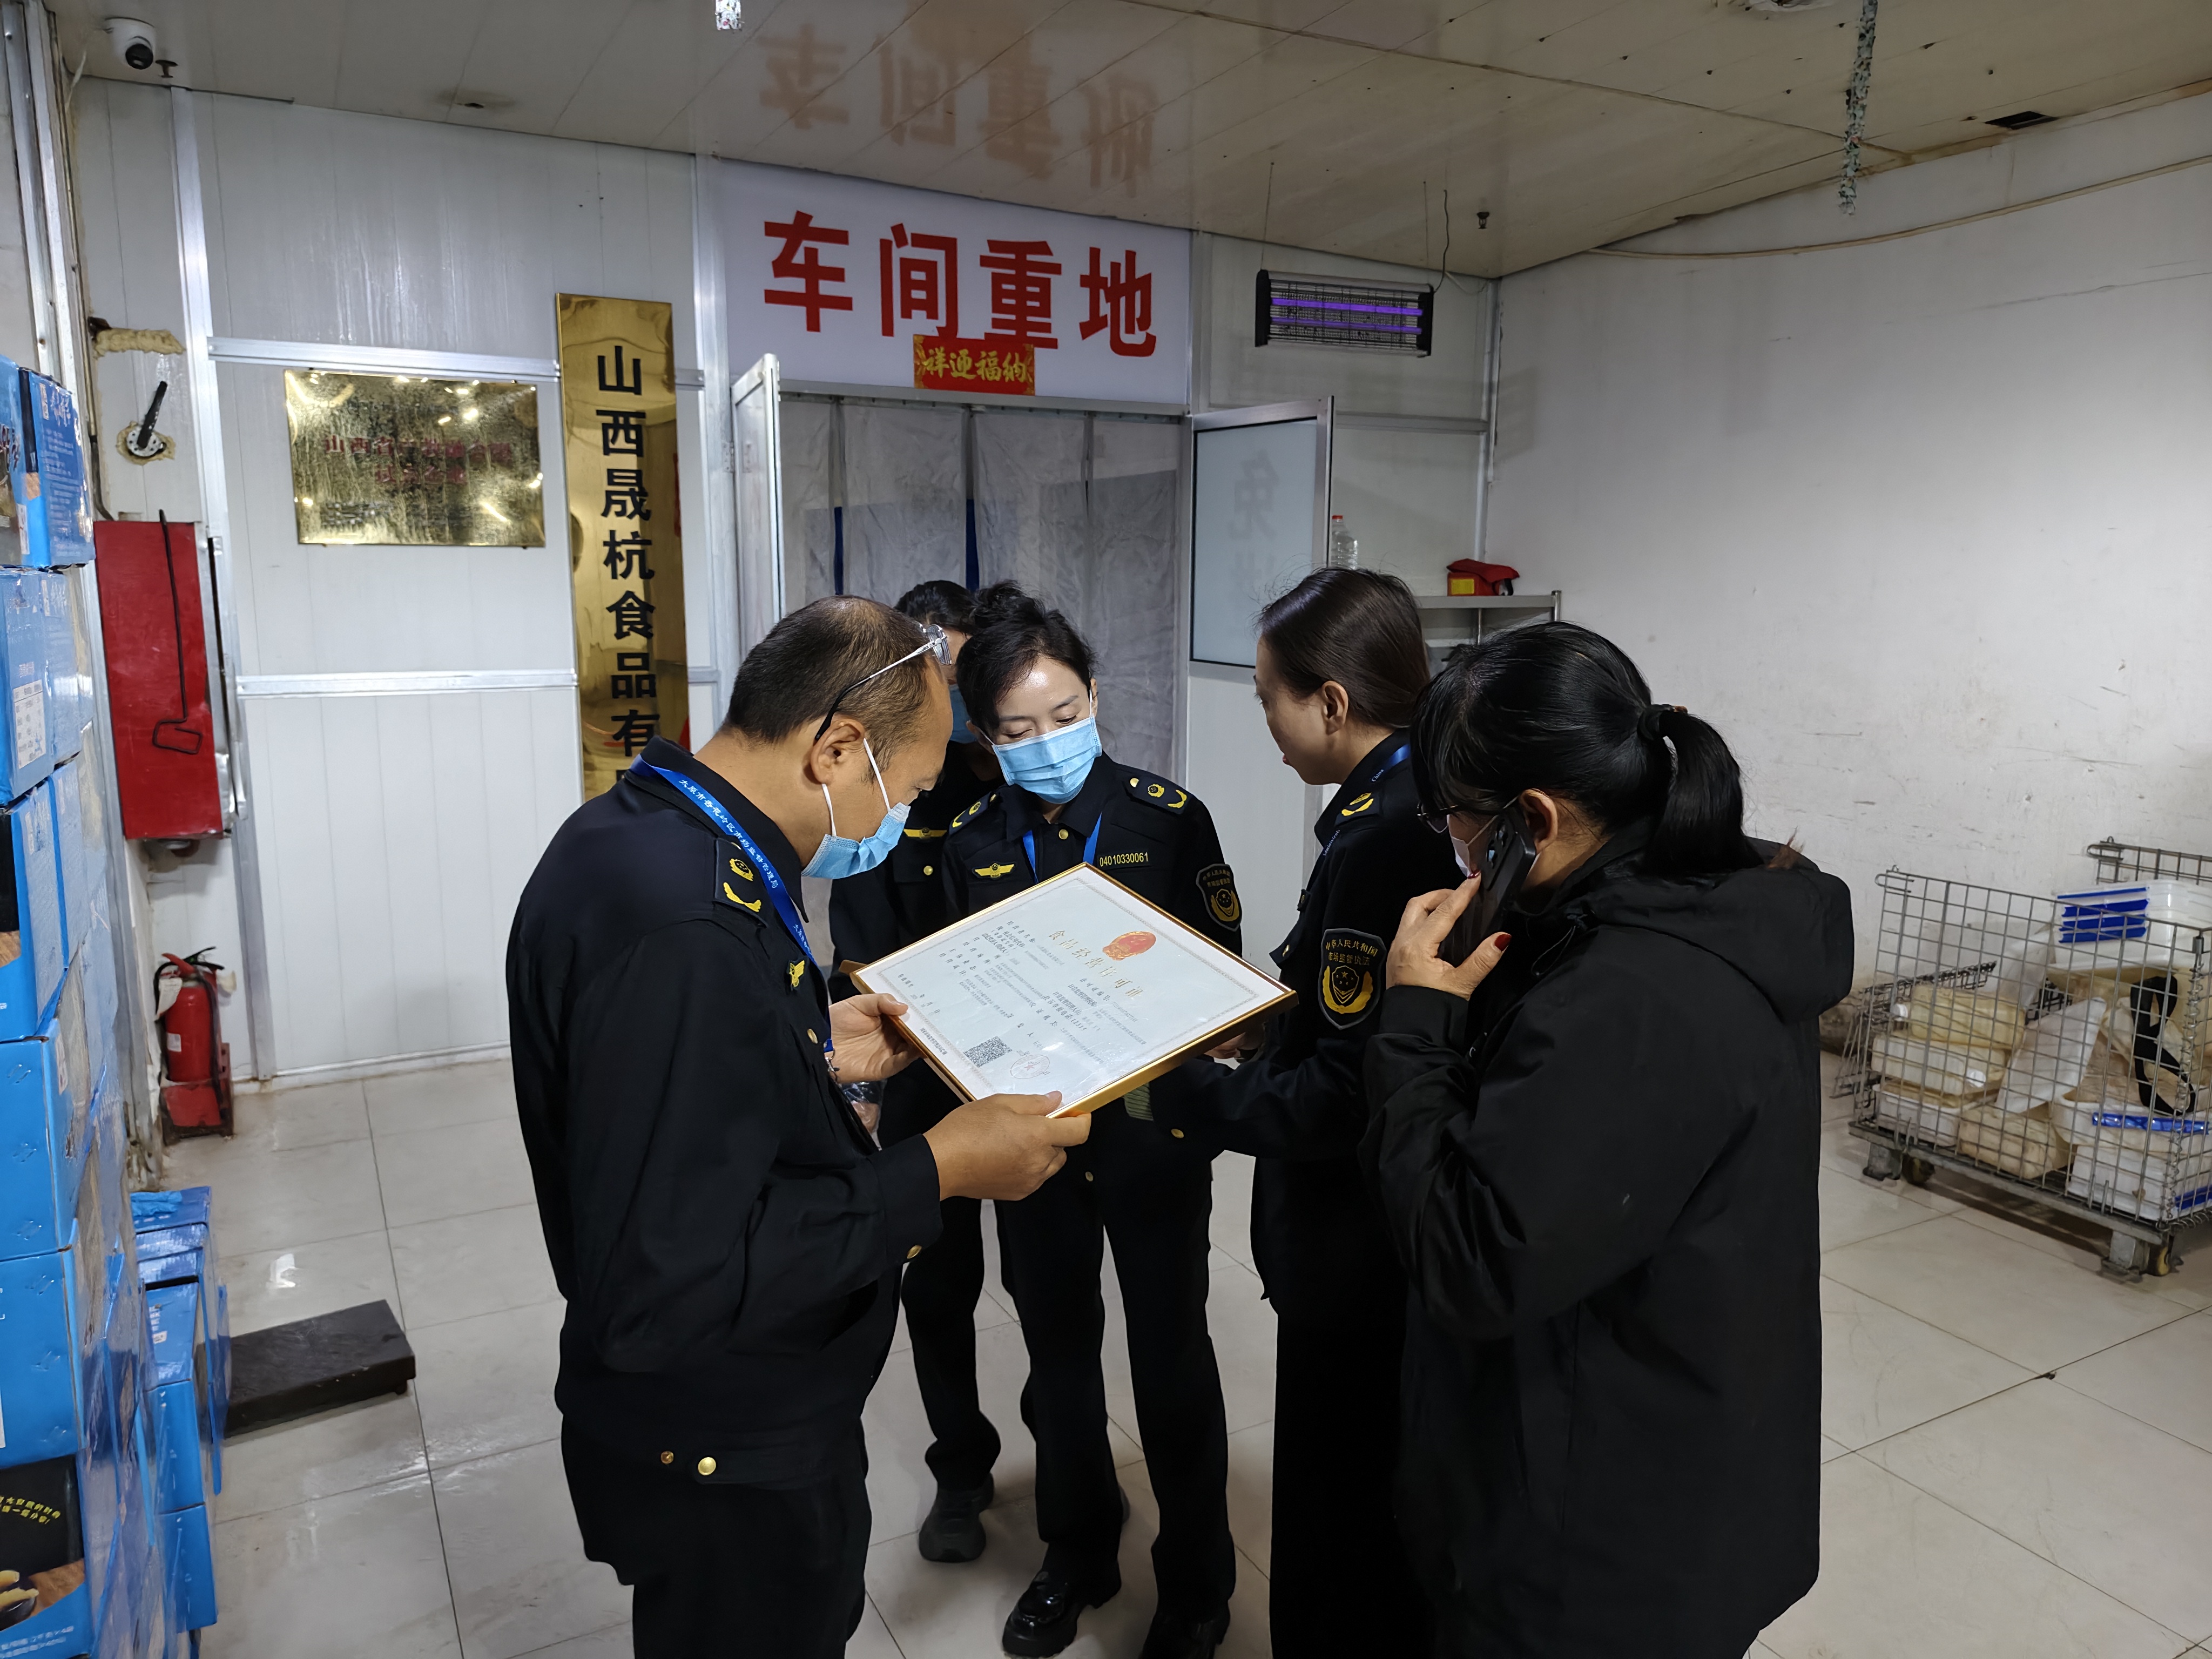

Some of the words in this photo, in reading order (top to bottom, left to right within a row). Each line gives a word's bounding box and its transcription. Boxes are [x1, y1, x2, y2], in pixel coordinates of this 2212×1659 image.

[764, 210, 1156, 358] 车间重地
[596, 346, 660, 782] 山西晟杭食品有
[1371, 769, 1384, 782] China
[678, 779, 779, 889] 太原市杏花岭区市场监督管理局
[1100, 852, 1148, 866] 04010330061
[1325, 939, 1378, 956] 中华人民共和国
